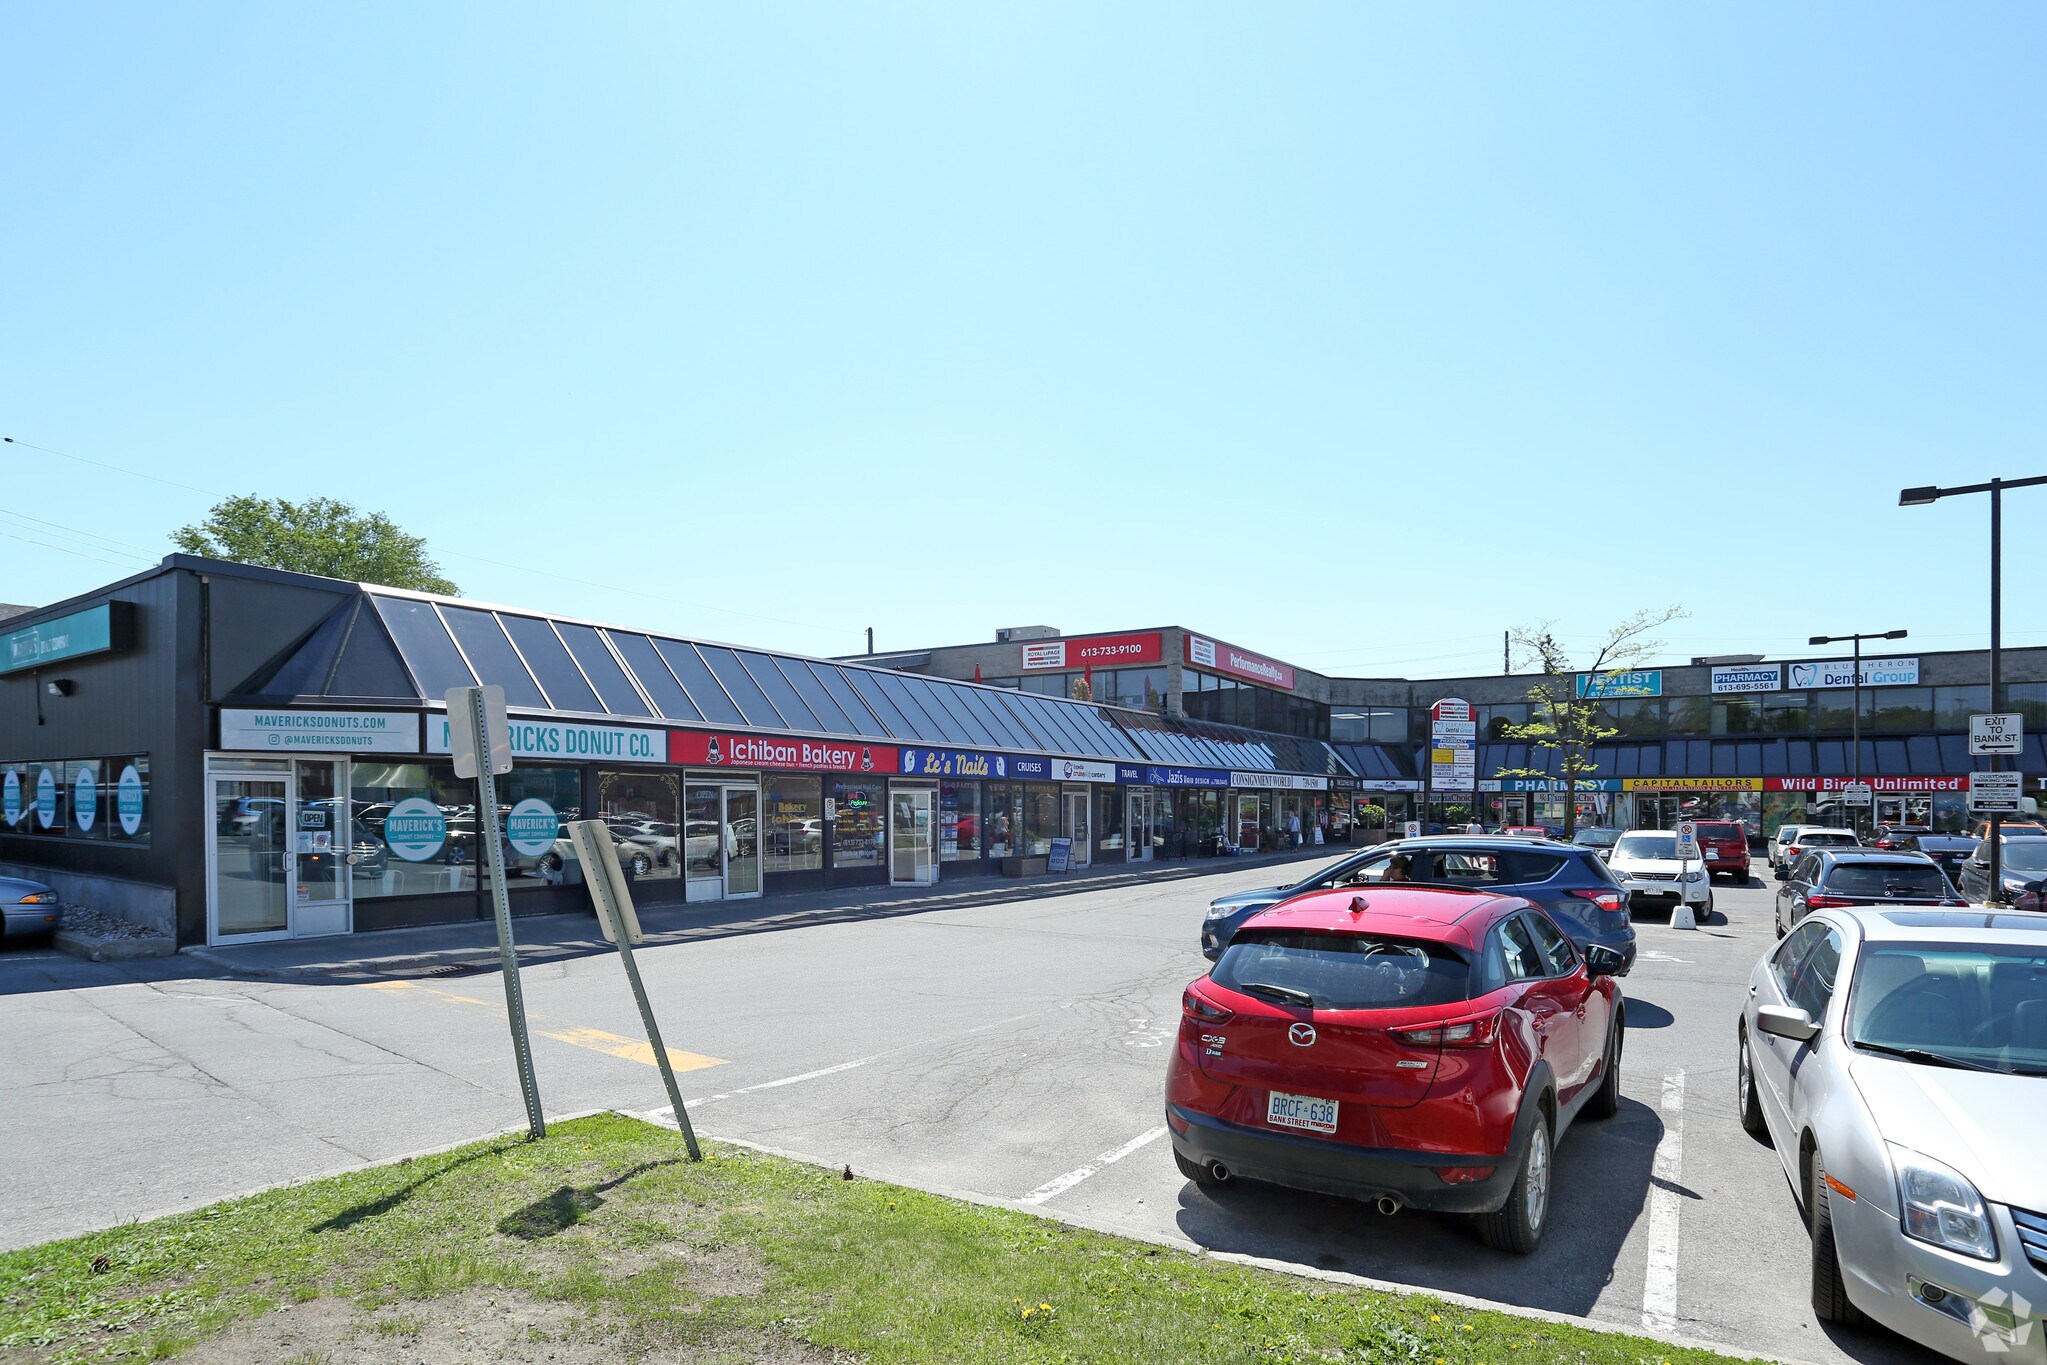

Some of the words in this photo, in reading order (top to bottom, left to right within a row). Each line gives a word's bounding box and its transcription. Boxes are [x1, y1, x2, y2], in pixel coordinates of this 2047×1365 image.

[1080, 643, 1142, 657] 613-733-9100
[1230, 652, 1283, 682] PerformanceRealty.ca
[1867, 660, 1915, 668] HERON
[1715, 671, 1777, 683] PHARMACY
[1824, 671, 1868, 686] Dental
[1872, 671, 1916, 684] Group
[1717, 682, 1774, 692] 613-695-5561
[254, 715, 386, 729] MAVERICKSDONUTS.COM
[1984, 717, 2007, 726] EXIT
[1989, 726, 2003, 734] TO
[284, 735, 373, 746] @MAVERICKSDONUTS
[566, 728, 625, 756] DONUT
[629, 733, 655, 758] CO.
[1974, 735, 2002, 743] BANK
[2004, 733, 2019, 742] ST.
[729, 738, 797, 762] Ichiban
[802, 743, 856, 769] Bakery
[923, 752, 952, 774] Le's
[955, 754, 989, 776] Nails
[1017, 761, 1042, 773] CRUISES
[1121, 769, 1138, 778] TRAVEL
[1194, 777, 1210, 785] DESIGN
[1231, 773, 1272, 787] CONSIGNMENT
[1273, 776, 1292, 787] WORLD
[1633, 779, 1689, 787] CAPITAL
[1693, 778, 1752, 787] TAILORS
[1781, 778, 1816, 790] Wild
[1874, 777, 1959, 790] Unlimited
[696, 790, 715, 799] OPEN
[778, 802, 808, 812] Bakery
[304, 813, 323, 823] OPEN
[510, 818, 556, 830] MAVERICK'S
[389, 819, 443, 832] MAVERICK'S
[1200, 1033, 1227, 1045] CX-3
[1272, 1096, 1303, 1118] BRCF
[1310, 1103, 1334, 1123] 638
[1269, 1114, 1287, 1124] BANK
[1286, 1117, 1310, 1128] STREET
[1310, 1121, 1335, 1130] mazda
